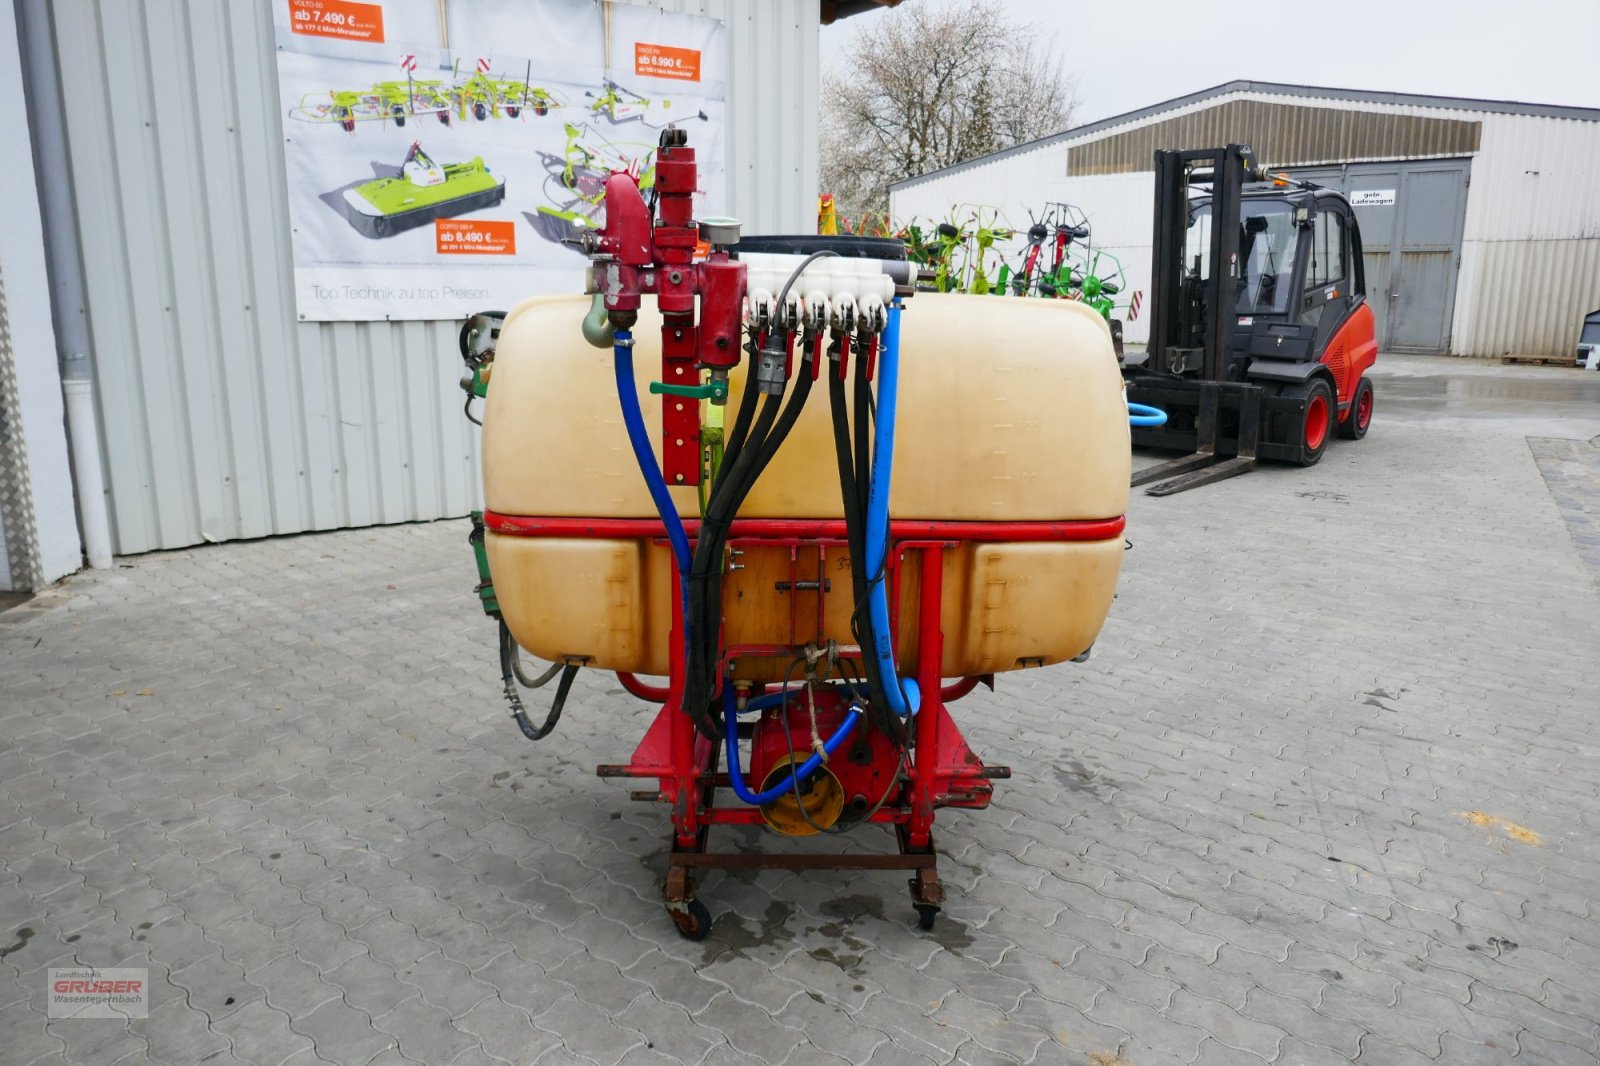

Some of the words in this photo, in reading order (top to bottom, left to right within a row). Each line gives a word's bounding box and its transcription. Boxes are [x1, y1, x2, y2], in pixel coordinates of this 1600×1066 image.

[295, 9, 310, 21] ab
[313, 11, 345, 25] 7.490
[347, 15, 356, 27] €
[638, 55, 650, 65] ab
[651, 56, 674, 68] 6.990
[675, 59, 682, 69] €
[440, 231, 454, 242] ab
[455, 232, 483, 243] 8.490
[484, 232, 492, 243] €
[312, 285, 339, 301] Top
[343, 285, 395, 300] Technik
[399, 288, 414, 300] zu
[418, 286, 440, 301] top
[442, 286, 491, 300] Preisen.
